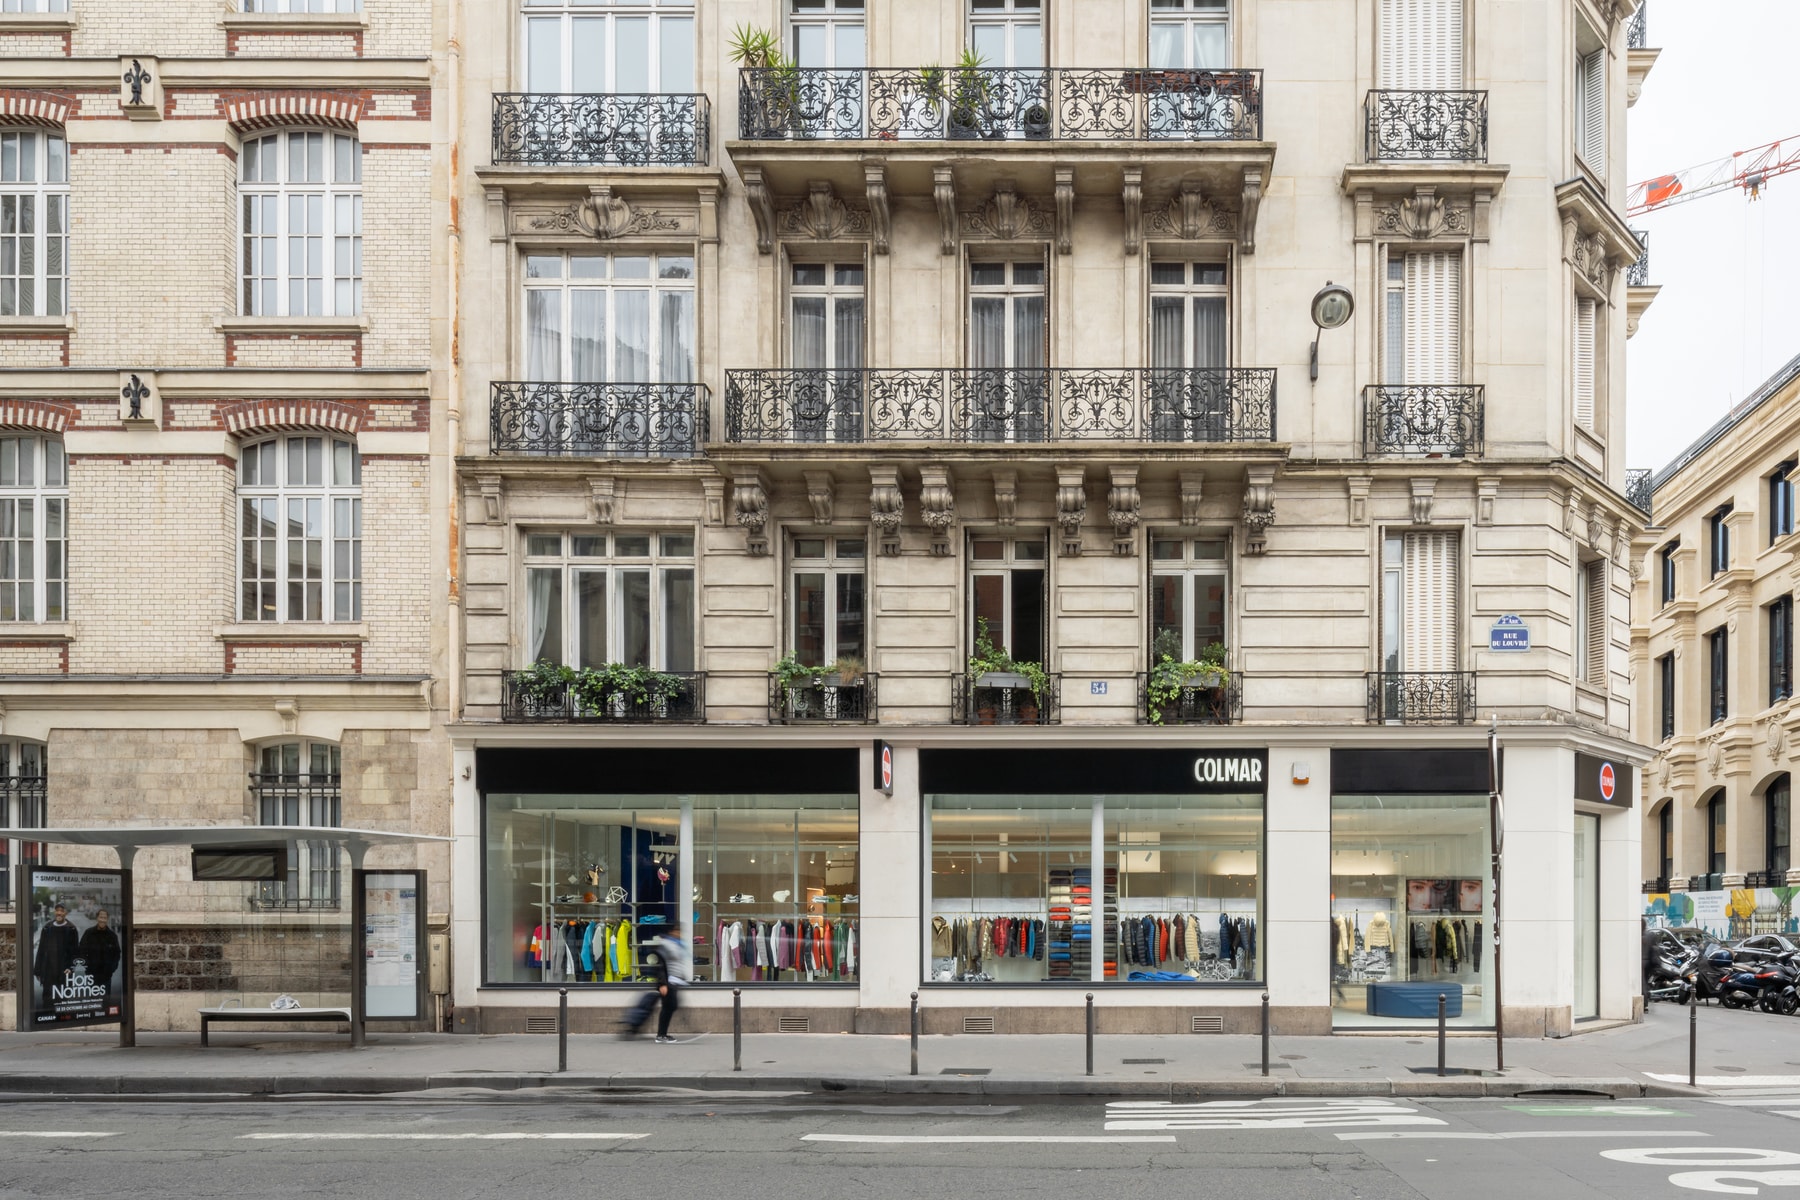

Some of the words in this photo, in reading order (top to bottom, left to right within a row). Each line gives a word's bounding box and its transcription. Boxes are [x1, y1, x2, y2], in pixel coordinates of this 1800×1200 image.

[1092, 682, 1106, 694] 54
[1194, 757, 1262, 782] COLMAR
[65, 972, 94, 987] Hors
[52, 984, 106, 999] Normes
